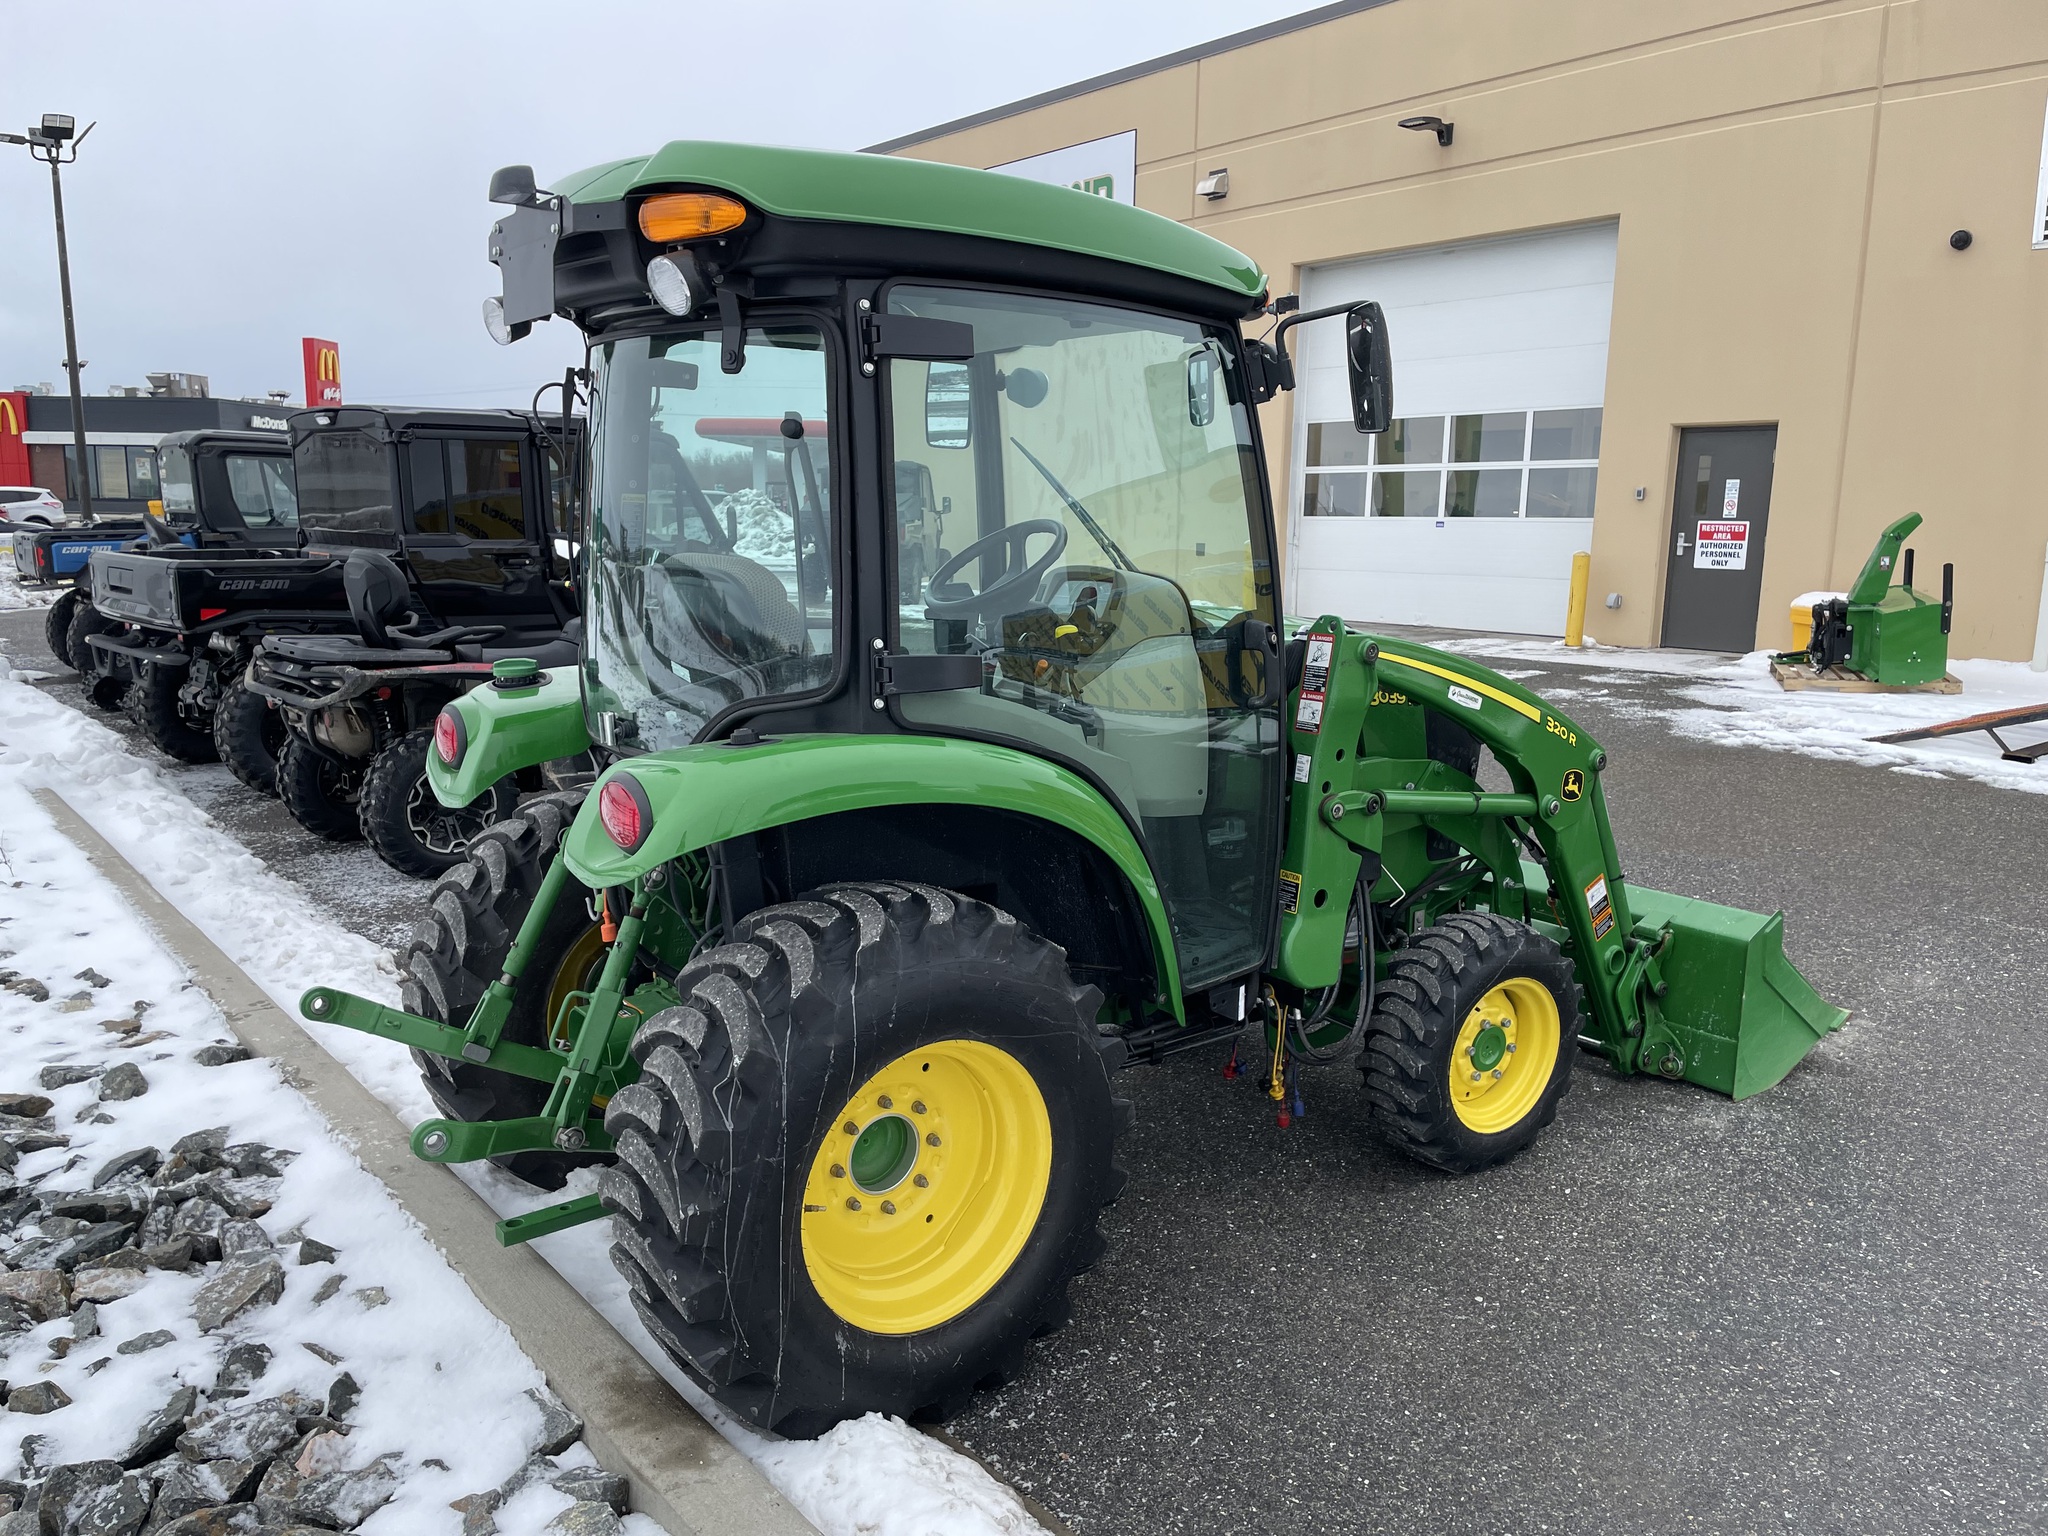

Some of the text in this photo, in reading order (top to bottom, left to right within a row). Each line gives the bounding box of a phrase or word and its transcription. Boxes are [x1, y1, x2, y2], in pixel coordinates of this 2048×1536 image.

[251, 415, 288, 431] McDonal
[1699, 542, 1743, 550] AUTHORIZED
[1711, 559, 1729, 567] ONLY
[219, 579, 290, 591] can-am
[1306, 693, 1324, 701] DANGER
[1546, 715, 1577, 747] 320 R
[1281, 870, 1301, 882] CAUTION
